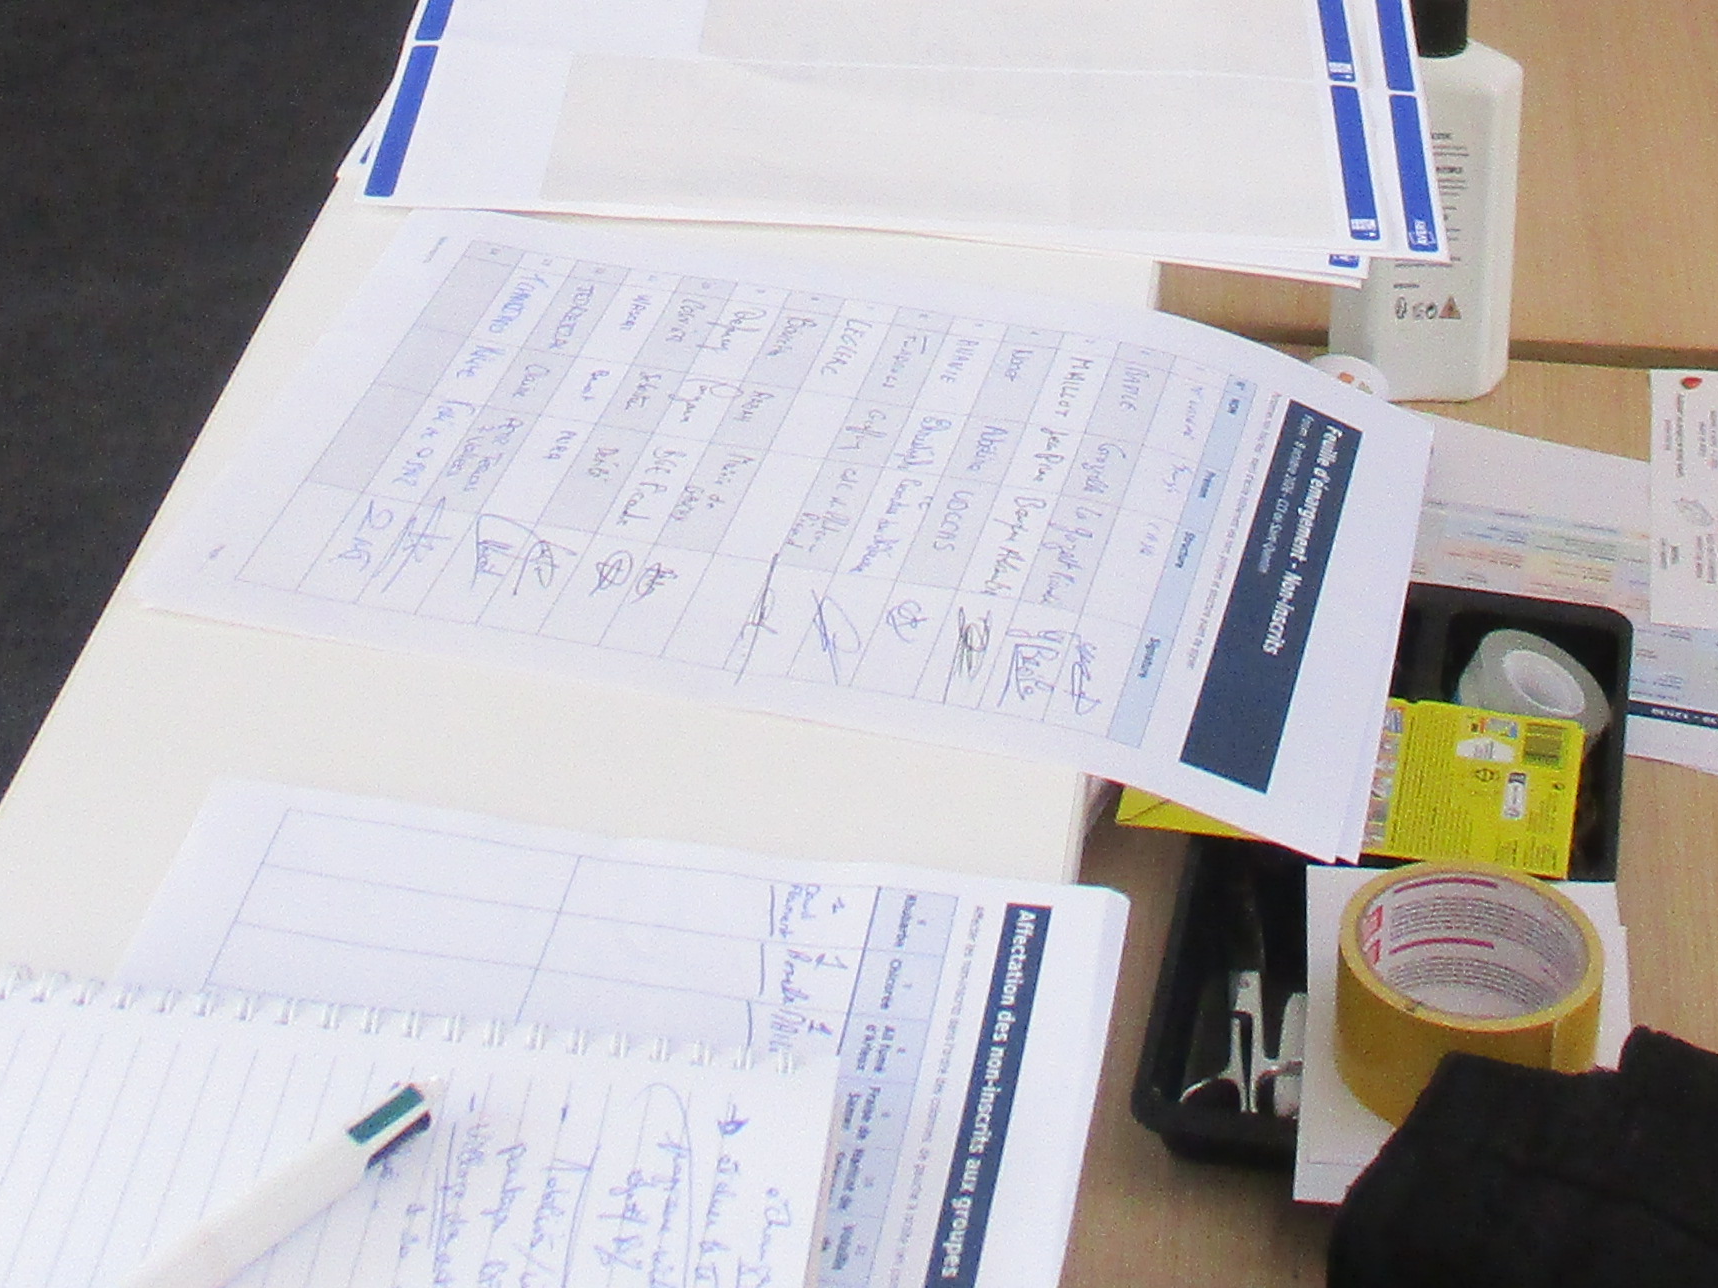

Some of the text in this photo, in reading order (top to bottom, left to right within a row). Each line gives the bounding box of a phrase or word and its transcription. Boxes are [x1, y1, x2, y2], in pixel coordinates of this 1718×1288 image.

[1316, 425, 1342, 466] Feuille
[1290, 467, 1329, 561] d'émargement
[1263, 571, 1301, 654] Non-inscrits
[941, 910, 1035, 1277] Affectation des non-inscrits aux groupes
